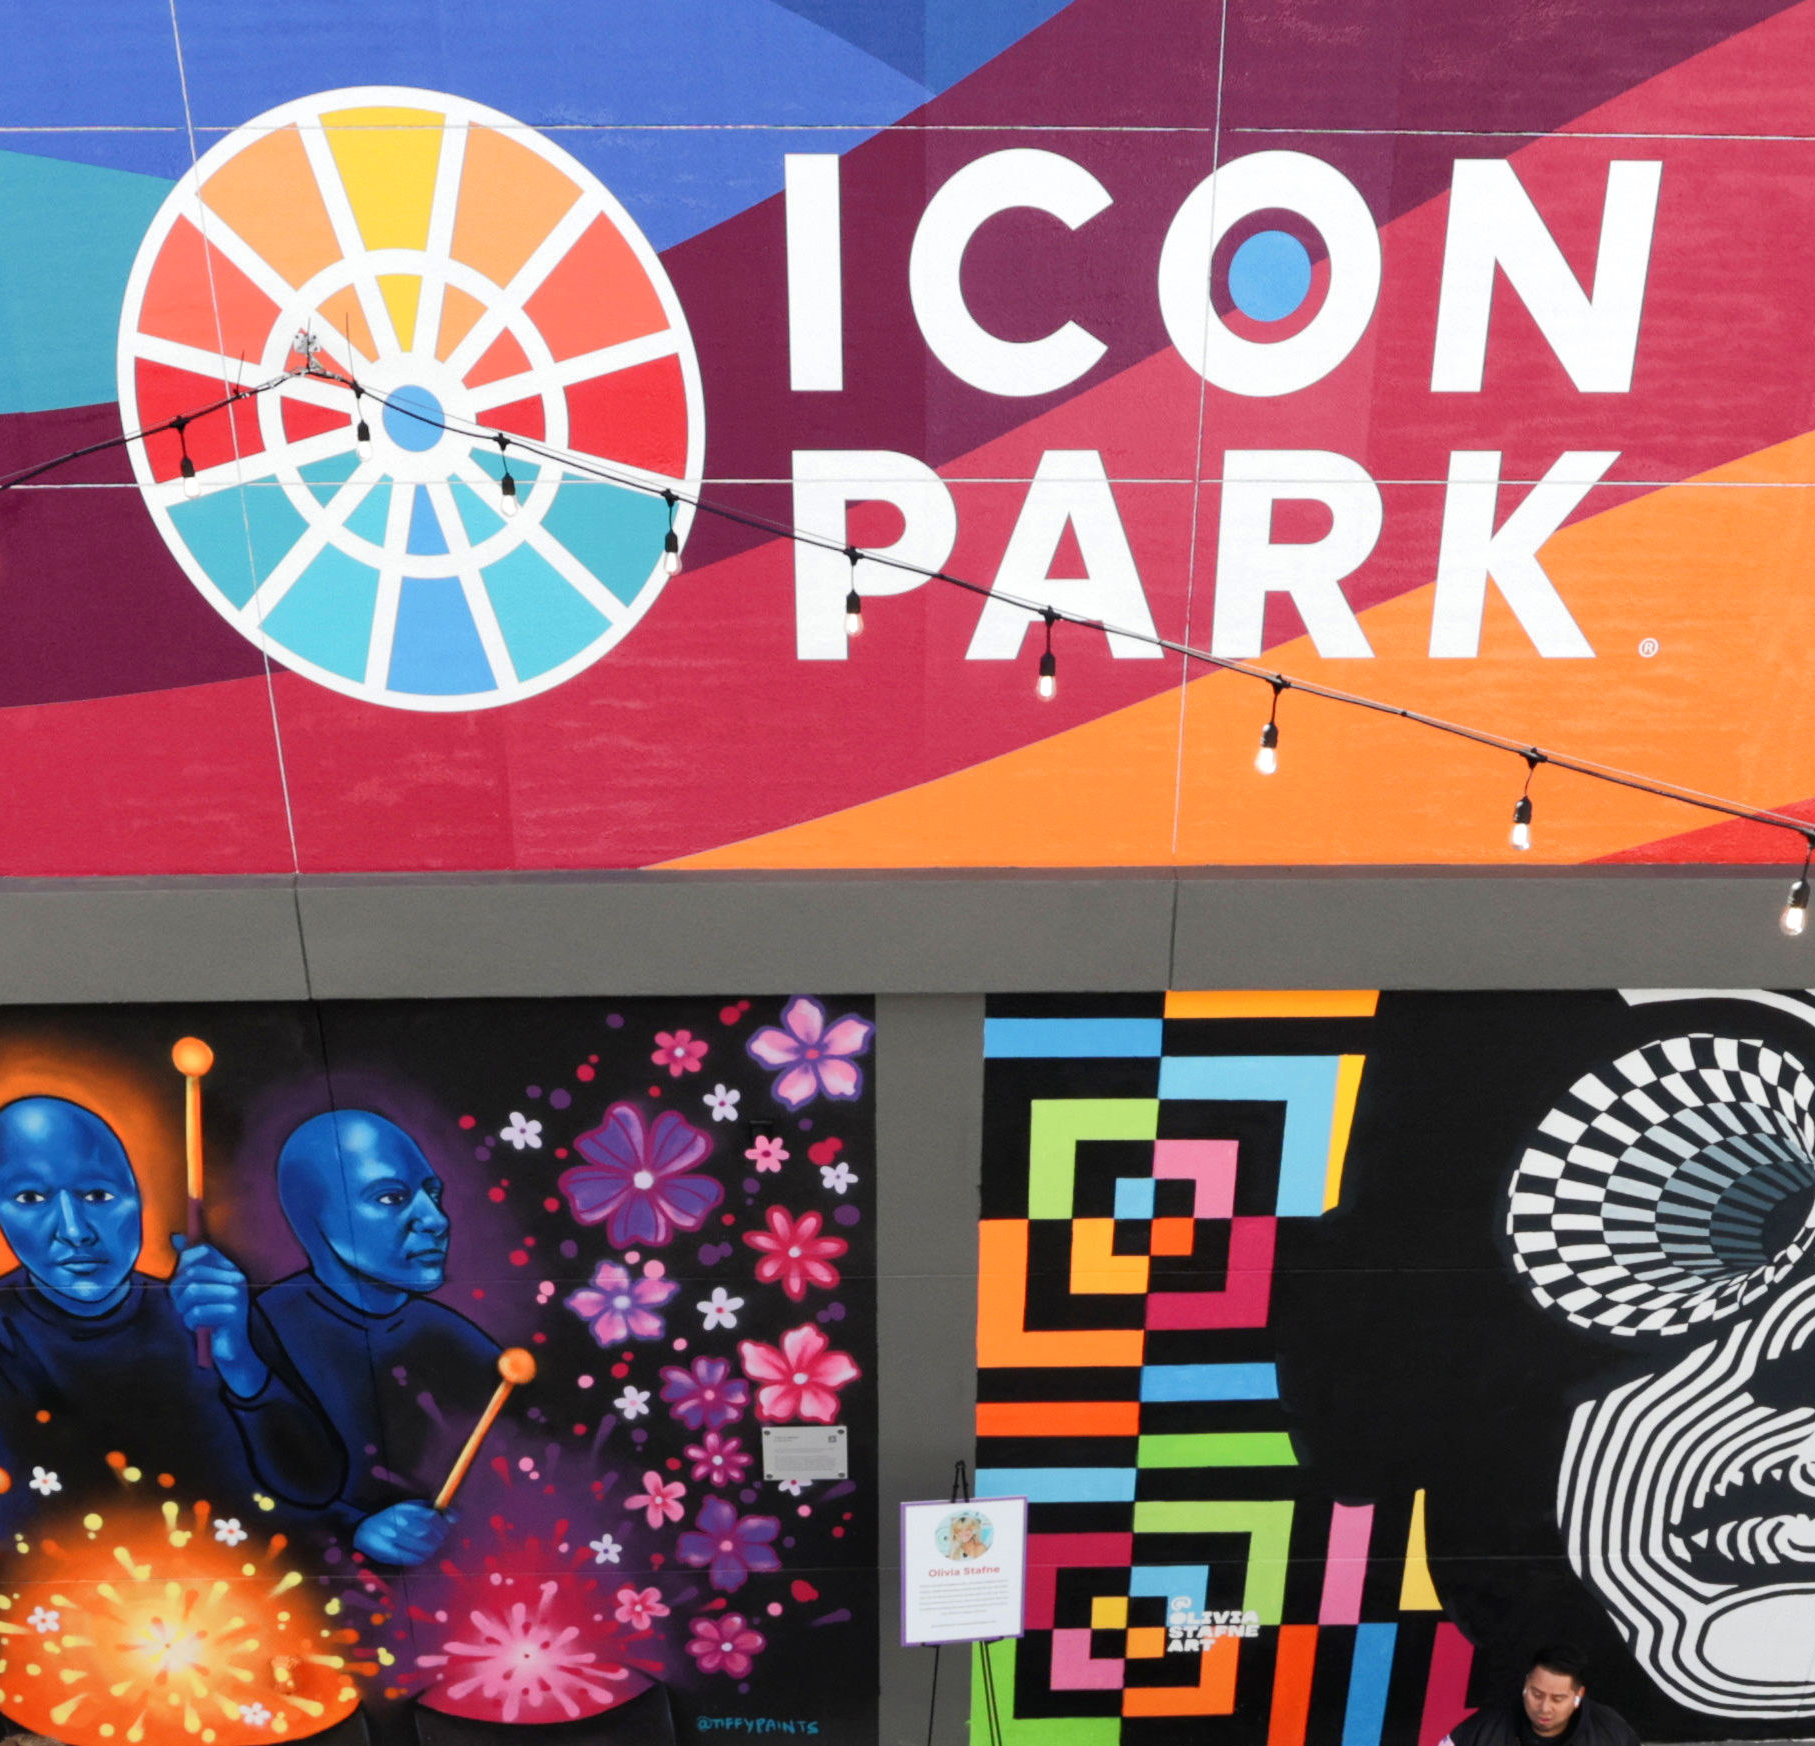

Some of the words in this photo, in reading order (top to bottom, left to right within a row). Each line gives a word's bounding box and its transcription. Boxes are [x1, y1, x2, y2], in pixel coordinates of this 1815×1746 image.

[785, 148, 1663, 398] ICON
[792, 449, 1624, 662] PARK
[928, 1567, 960, 1578] Olivia
[963, 1565, 1001, 1576] Stafne
[1170, 1596, 1192, 1612] @
[1168, 1610, 1260, 1625] OLIVIA
[1168, 1624, 1261, 1639] STAFNE
[1166, 1638, 1217, 1653] ART
